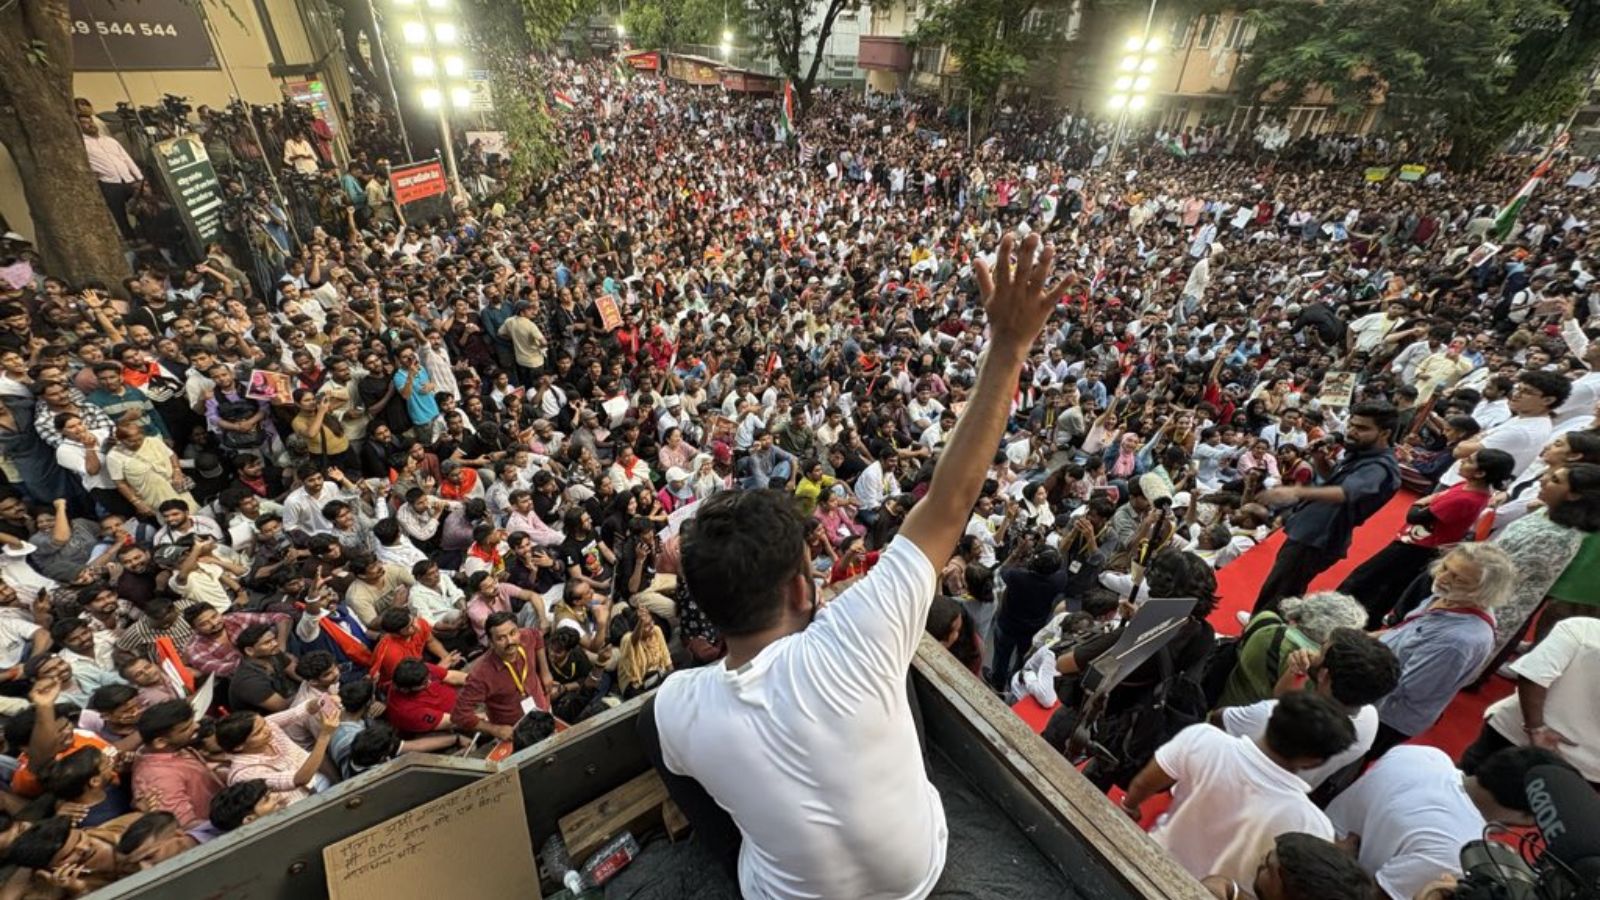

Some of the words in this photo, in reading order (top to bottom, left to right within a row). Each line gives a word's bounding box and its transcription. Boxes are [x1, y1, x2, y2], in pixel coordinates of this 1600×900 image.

[96, 21, 136, 35] 544
[139, 23, 177, 36] 544
[368, 838, 396, 858] BMC
